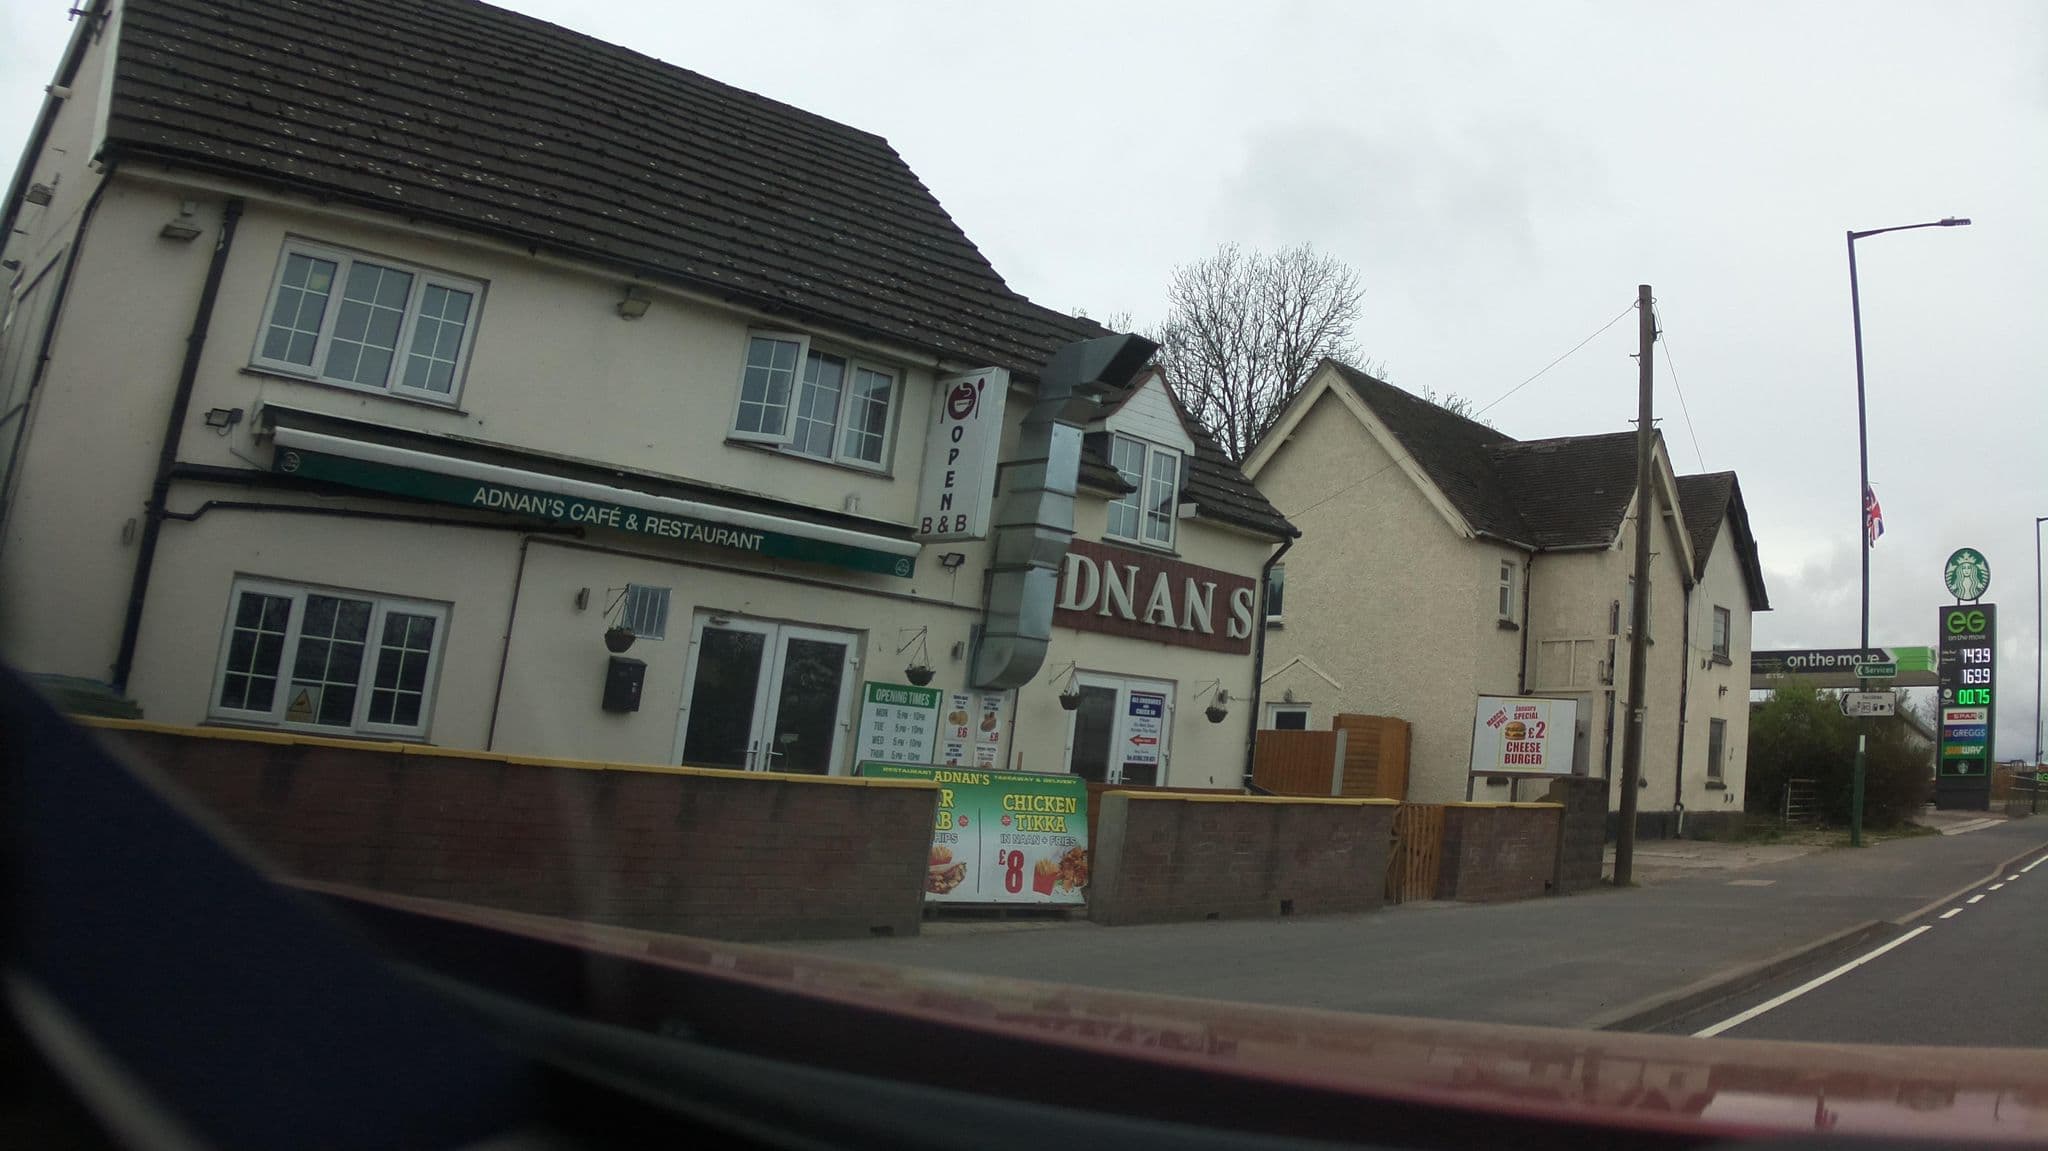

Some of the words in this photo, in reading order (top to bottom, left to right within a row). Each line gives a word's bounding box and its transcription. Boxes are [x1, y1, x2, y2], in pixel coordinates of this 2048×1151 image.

[940, 425, 964, 511] OPEN
[472, 487, 565, 518] ADNAN'S
[569, 503, 620, 528] CAFÉ
[625, 514, 639, 531] &
[644, 516, 765, 551] RESTAURANT
[1786, 655, 1807, 667] on
[1808, 652, 1835, 667] the
[1837, 653, 1880, 666] moe
[876, 688, 908, 704] OPENING
[908, 691, 931, 706] TIMES
[1513, 712, 1538, 720] SPECIAL
[871, 735, 885, 745] WED
[1952, 729, 1986, 738] GREGGS
[1506, 741, 1541, 753] CHEESE
[1504, 753, 1543, 765] BURGER
[933, 770, 990, 786] ADNAN'S
[1002, 793, 1078, 814] CHICKEN
[1015, 813, 1068, 833] TIKKA
[1000, 833, 1011, 844] IN
[1049, 835, 1077, 847] FRIES
